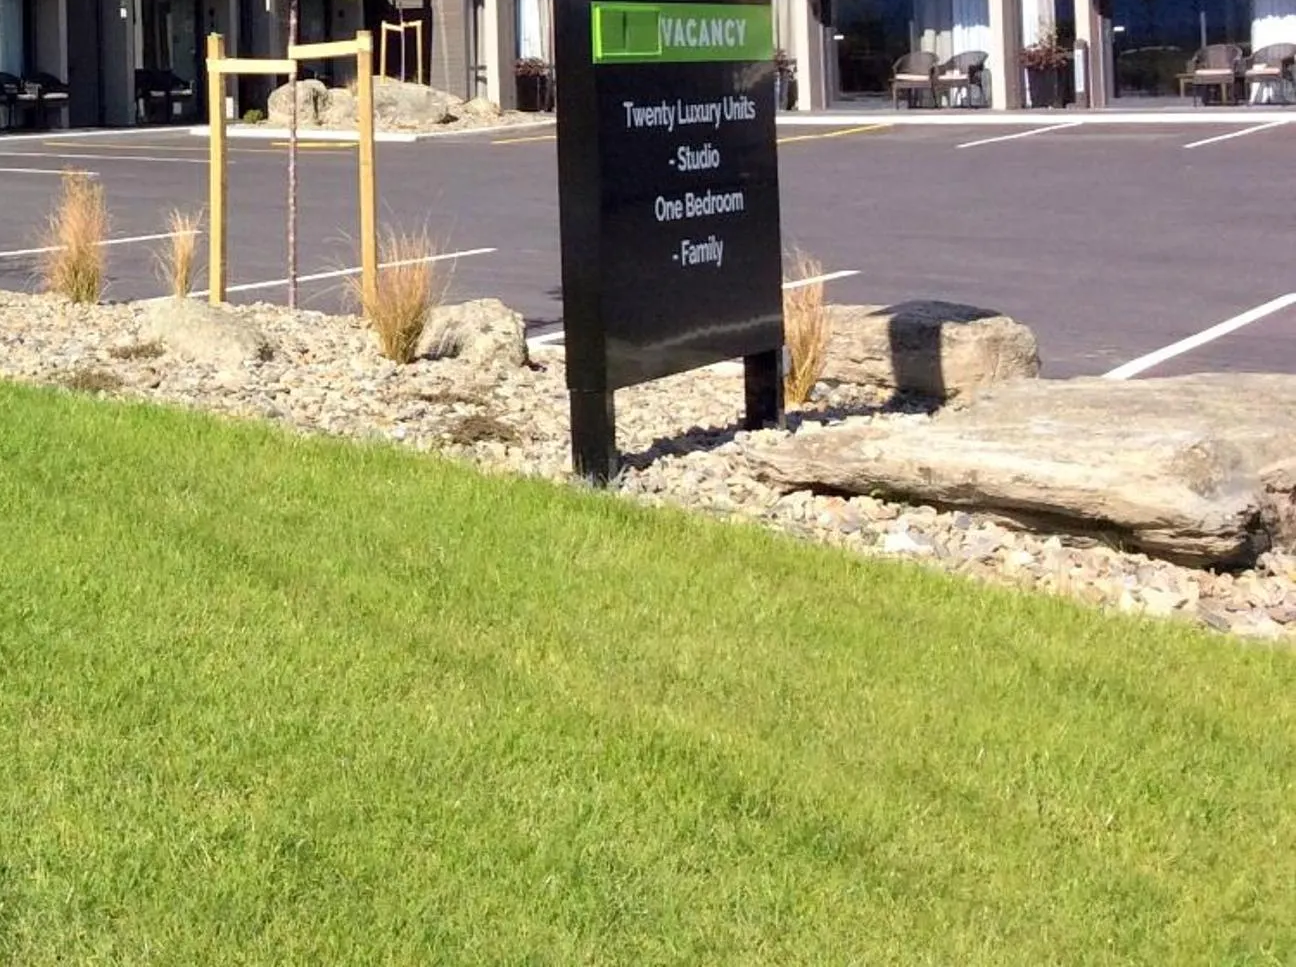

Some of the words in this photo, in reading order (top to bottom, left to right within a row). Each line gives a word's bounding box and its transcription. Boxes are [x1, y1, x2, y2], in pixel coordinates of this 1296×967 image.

[661, 17, 747, 48] VACANCY
[623, 100, 676, 133] Twenty
[678, 98, 722, 129] Luxury
[723, 96, 756, 121] Units
[677, 143, 720, 172] Studio
[654, 195, 683, 222] One
[685, 190, 744, 217] Bedroom
[681, 235, 724, 266] Family
